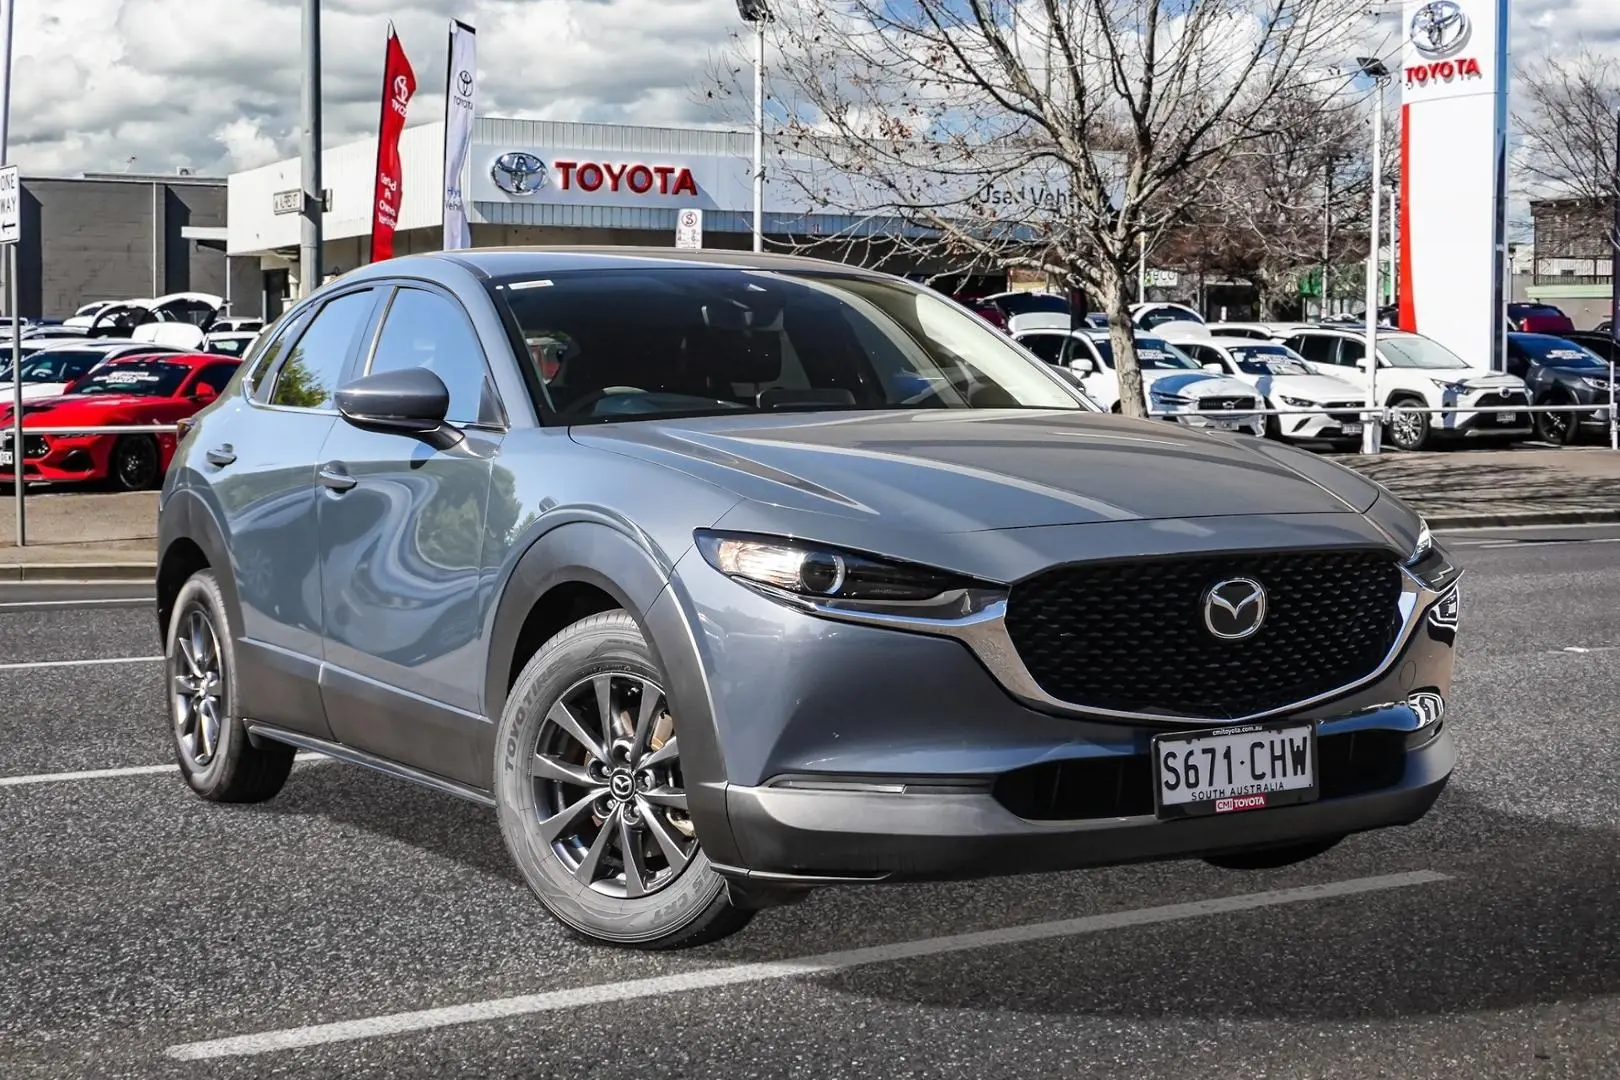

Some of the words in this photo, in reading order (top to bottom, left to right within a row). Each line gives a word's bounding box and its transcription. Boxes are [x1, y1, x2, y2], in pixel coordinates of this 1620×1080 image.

[1404, 58, 1481, 83] TOYOTA
[1, 173, 16, 191] ONE
[555, 161, 698, 196] TOYOTA
[978, 184, 1025, 204] Used
[1, 196, 17, 214] WAY
[1191, 789, 1226, 801] SOUTH
[1230, 781, 1285, 796] AUSTRALIA
[1217, 800, 1233, 810] CMI
[1233, 796, 1265, 809] TOYOTA
